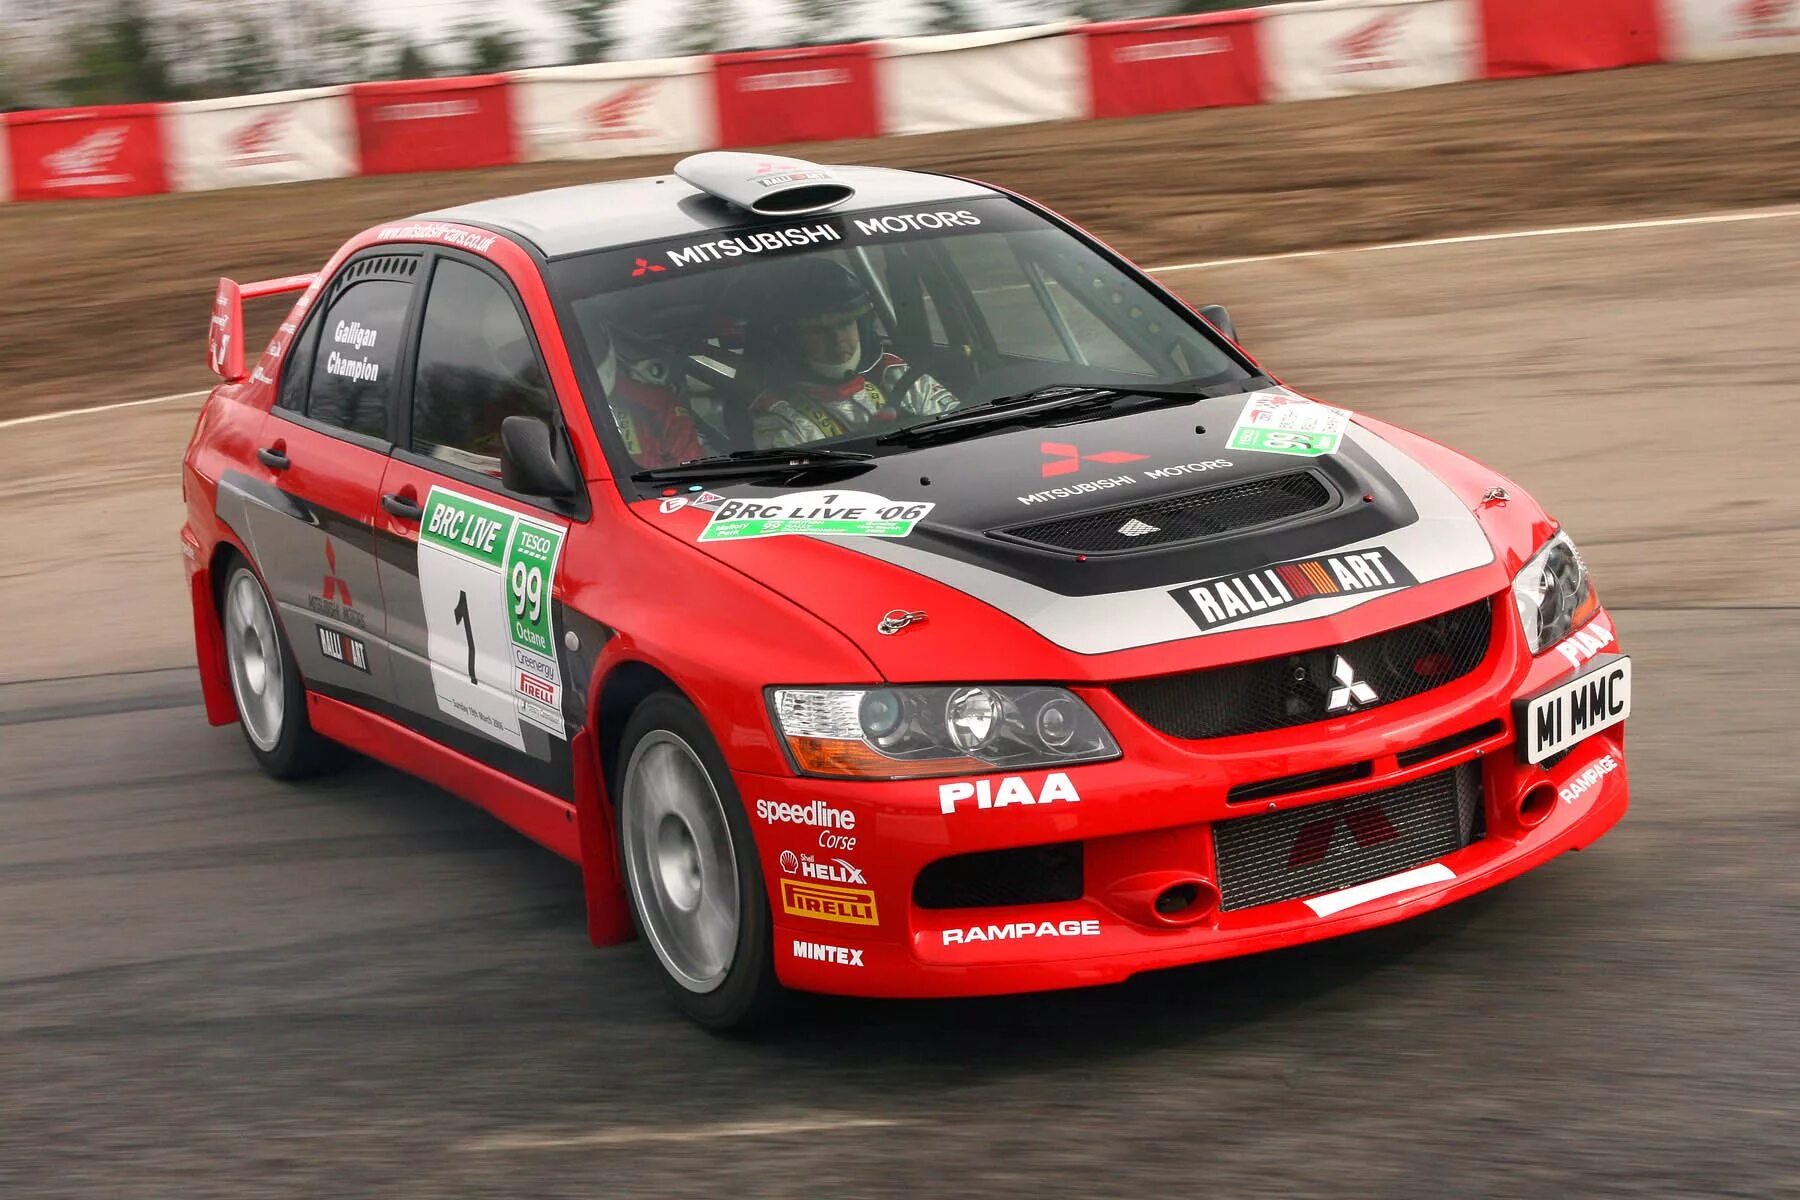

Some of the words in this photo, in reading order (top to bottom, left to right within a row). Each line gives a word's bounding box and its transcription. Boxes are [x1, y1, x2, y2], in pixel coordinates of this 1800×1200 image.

[666, 224, 842, 268] MITSUBISHI
[853, 210, 982, 236] MOTORS
[334, 320, 377, 350] Galligan
[327, 351, 379, 382] Champion
[1016, 475, 1137, 506] MITSUBISHI
[1144, 458, 1234, 480] MOTORS
[715, 501, 783, 521] BRC
[788, 507, 866, 520] LIVE
[823, 494, 841, 505] 1
[428, 503, 465, 540] BRC
[461, 514, 502, 553] LIVE
[519, 531, 551, 554] TESCO
[512, 561, 543, 622] 99
[454, 590, 478, 686] 1
[516, 622, 546, 649] Octane
[1555, 622, 1615, 668] PIAA
[516, 650, 554, 680] Greenergy
[520, 672, 554, 705] PIRELLI
[1571, 669, 1624, 736] MMC
[938, 772, 1081, 815] PIAA
[1558, 755, 1619, 804] RAMPAGE
[756, 799, 856, 830] speedline
[818, 830, 857, 851] Corse
[801, 860, 868, 885] HELIX
[783, 883, 872, 920] PIRELLI
[942, 920, 1101, 946] RAMPAGE
[793, 940, 864, 967] MINTEX
